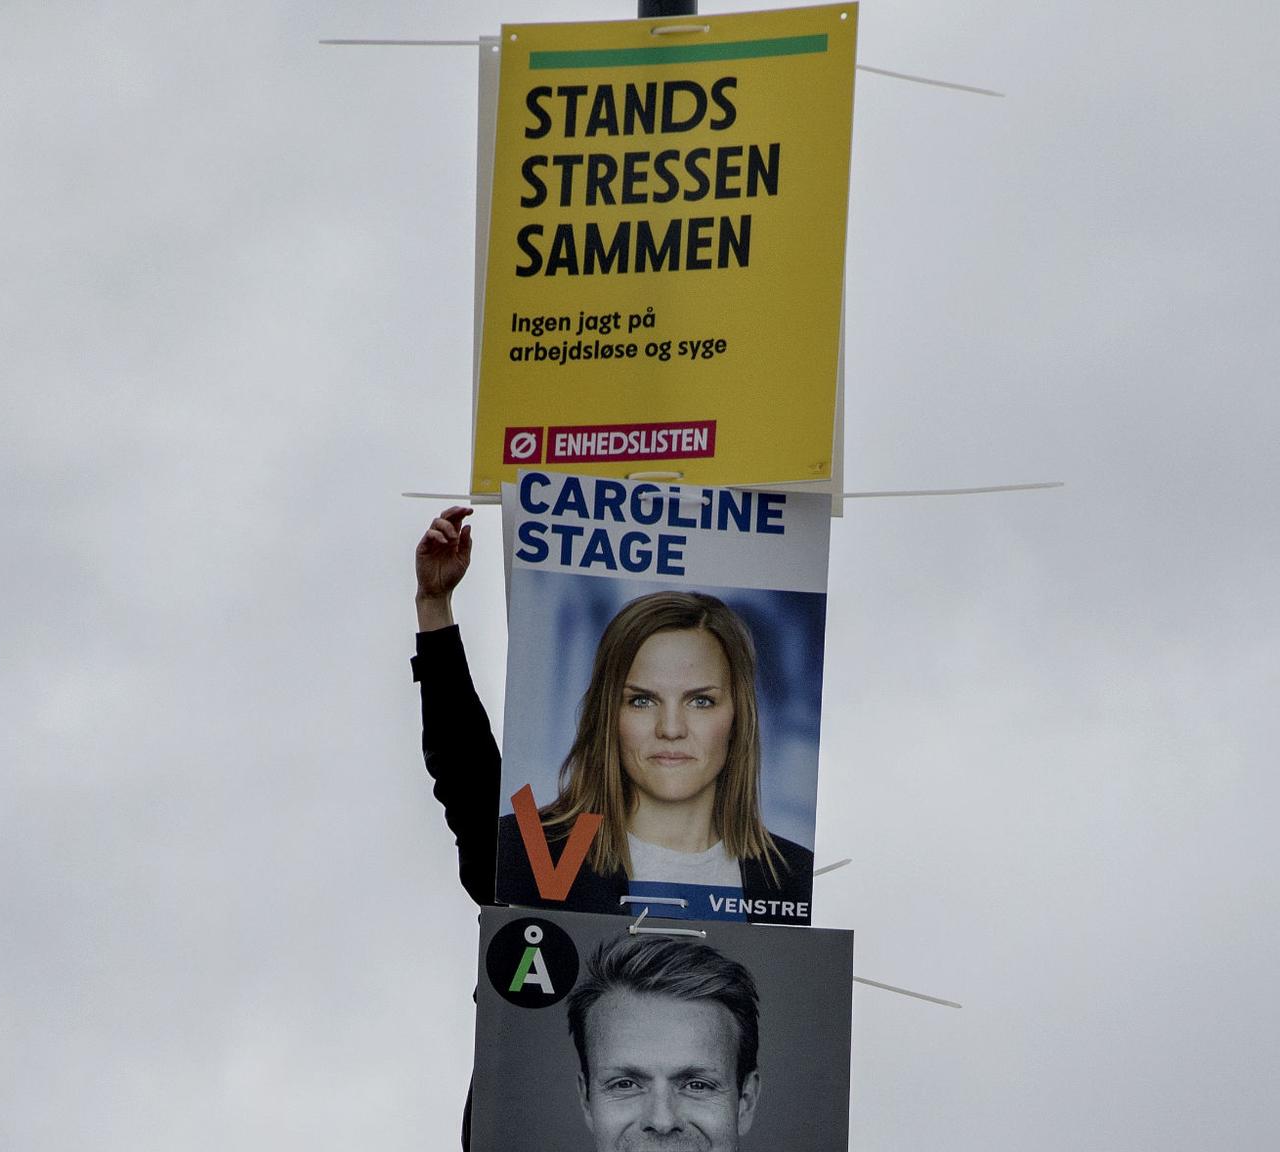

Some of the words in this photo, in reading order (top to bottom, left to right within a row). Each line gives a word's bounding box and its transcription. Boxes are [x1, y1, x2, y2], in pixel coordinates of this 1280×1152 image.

[524, 77, 738, 139] STANDS
[520, 143, 781, 208] STRESSEN
[515, 214, 752, 278] SAMMEN
[509, 340, 638, 366] arbejdsløse
[644, 340, 672, 361] og
[678, 338, 727, 360] syge
[511, 313, 571, 337] Ingen
[575, 311, 621, 336] jagt
[628, 306, 656, 333] på
[510, 432, 537, 459] Ø
[554, 428, 708, 457] ENHEDSLISTEN
[520, 472, 787, 535] CAROLINE
[515, 521, 687, 576] STAGE
[510, 783, 604, 901] V
[709, 894, 809, 917] VENSTRE
[508, 925, 555, 995] Å
